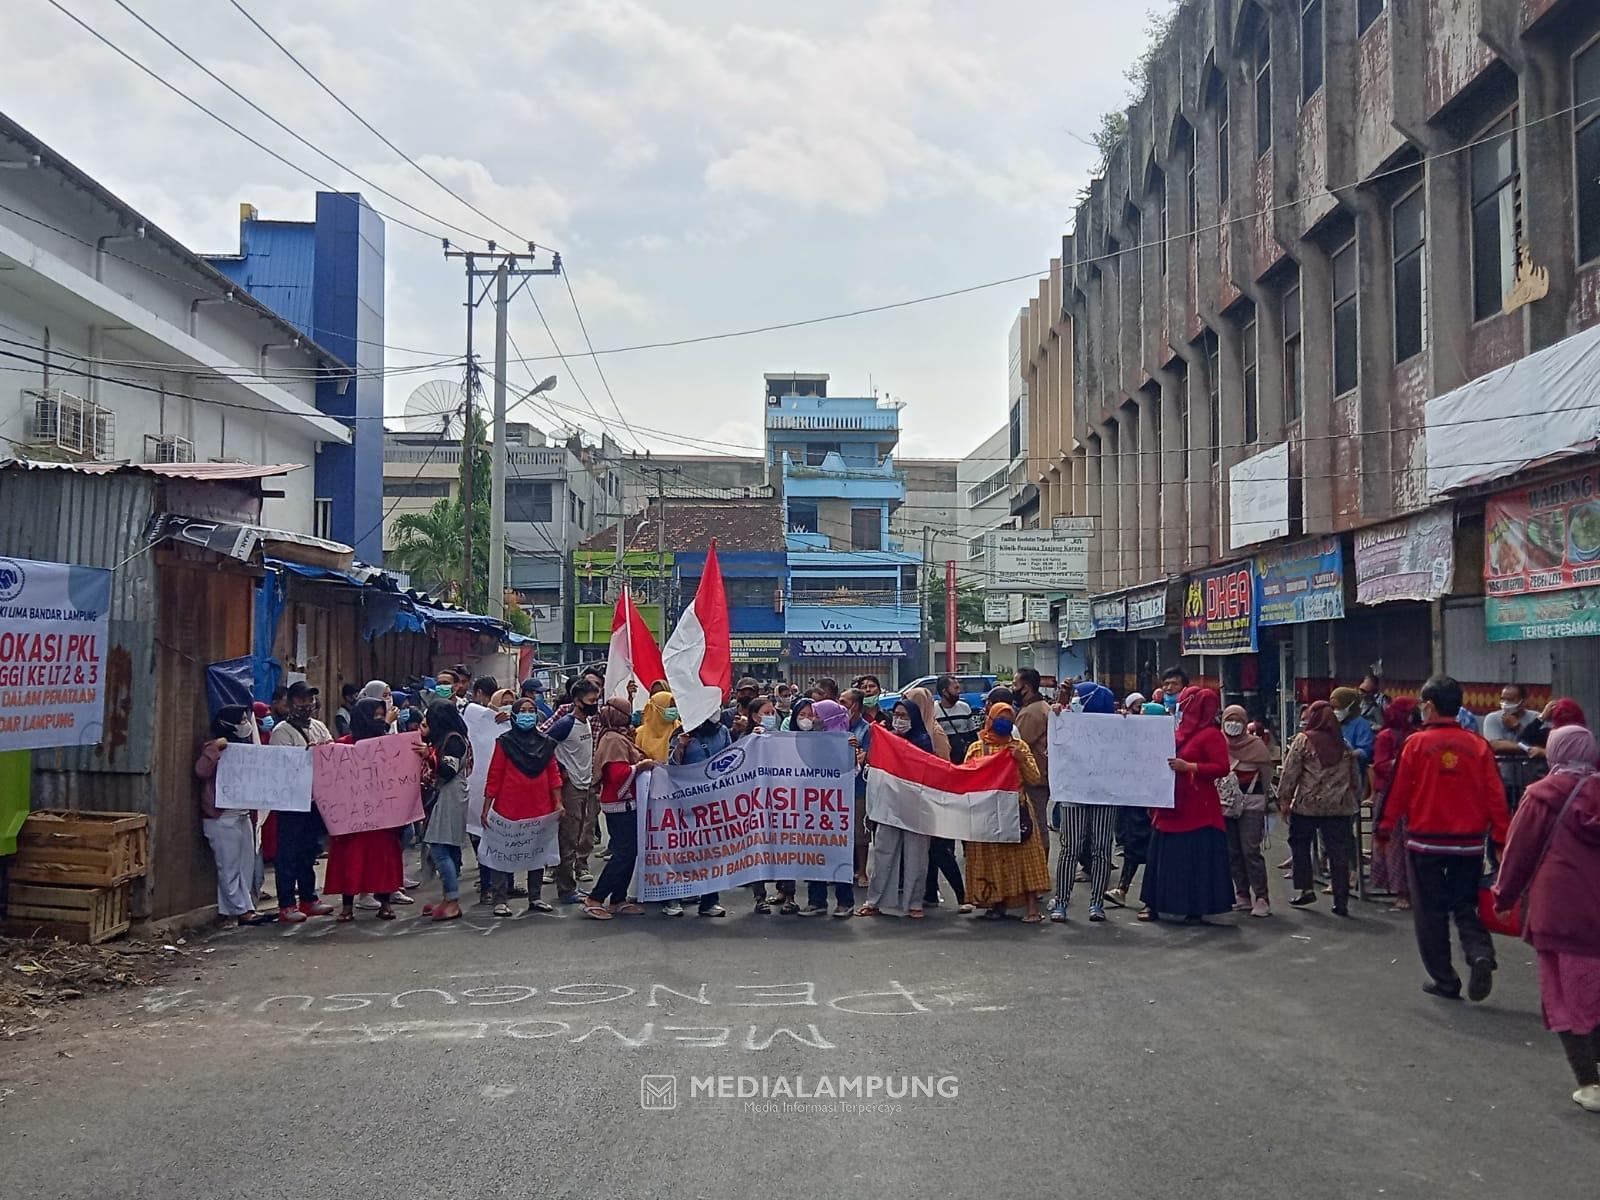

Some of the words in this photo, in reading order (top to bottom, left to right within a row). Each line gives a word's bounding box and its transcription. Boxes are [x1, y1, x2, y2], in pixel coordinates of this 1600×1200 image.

[1207, 570, 1250, 620] DHEA
[8, 607, 27, 619] LIMA
[29, 608, 61, 621] BANDAR
[63, 609, 98, 622] LAMPUNG
[0, 632, 63, 664] OKASI
[66, 634, 100, 663] PKL
[803, 640, 848, 652] TOKO
[849, 640, 903, 652] VOLTA
[28, 665, 46, 687] KE
[48, 665, 62, 686] LT
[63, 665, 71, 685] 2
[74, 665, 85, 685] &
[88, 665, 98, 685] 3
[2, 690, 42, 707] DALAM
[43, 688, 96, 706] PENATAAN
[23, 712, 75, 732] LAMPUNG
[712, 777, 735, 791] KAKI
[737, 769, 757, 784] LIMA
[794, 768, 841, 779] LAMPUNG
[691, 786, 796, 828] RELOKASI
[804, 788, 849, 812] PKL
[668, 812, 765, 850] BUKITTINGGI
[782, 813, 800, 829] LT
[804, 813, 815, 830] 2
[819, 813, 834, 830] &
[839, 813, 849, 831] 3
[781, 833, 848, 847] PENATAAN
[667, 868, 708, 884] PASAR
[711, 865, 723, 878] DI
[727, 852, 772, 875] BANDAR
